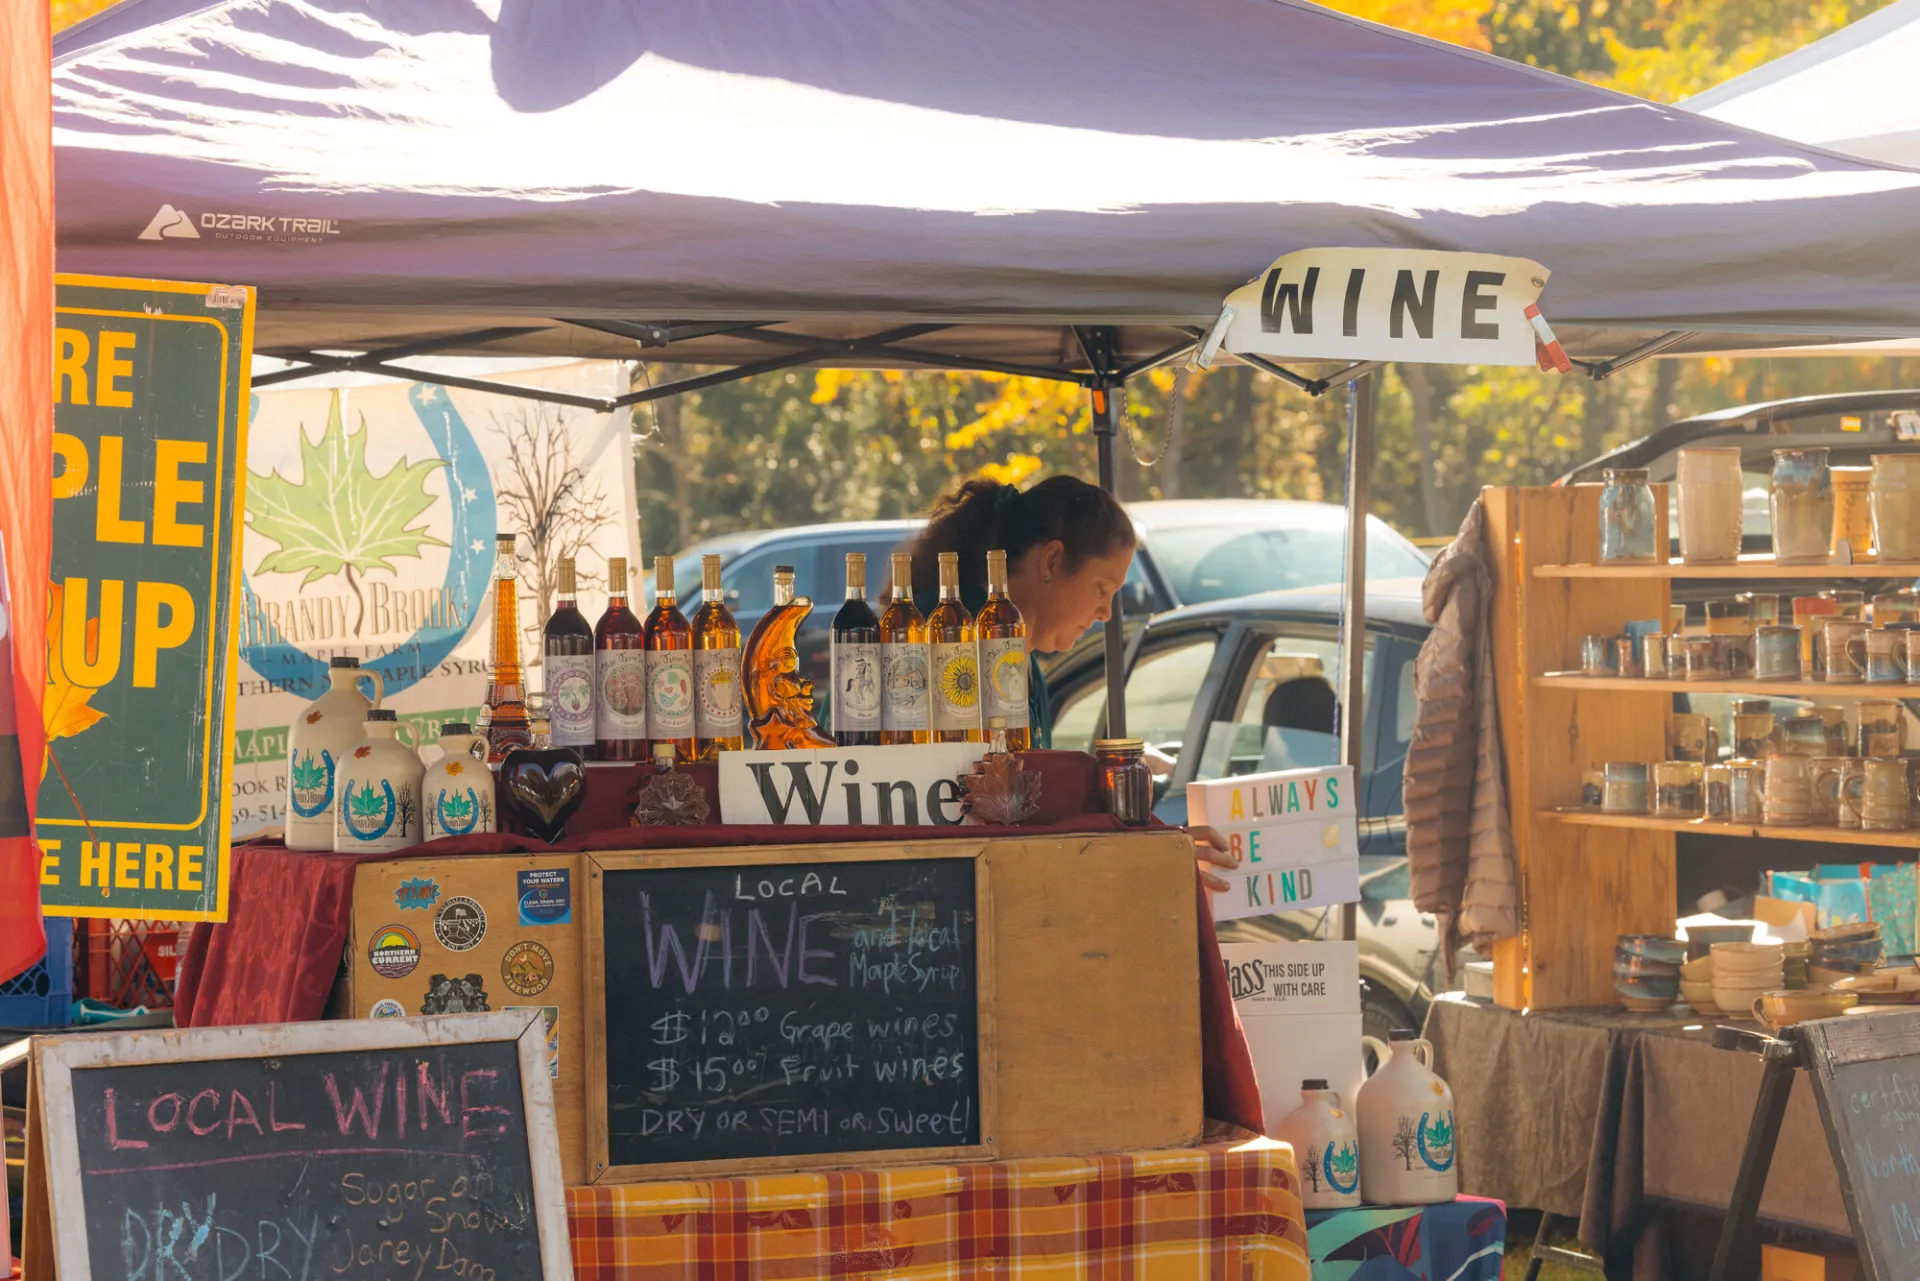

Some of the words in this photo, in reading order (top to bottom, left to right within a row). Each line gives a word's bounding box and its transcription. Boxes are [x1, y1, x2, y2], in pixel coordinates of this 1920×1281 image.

[215, 233, 262, 241] OUTDOOR
[267, 235, 323, 244] EQUIPMENT
[1260, 266, 1507, 340] WINE
[47, 577, 195, 688] UP
[243, 591, 351, 647] BRANDY
[370, 581, 463, 635] BROOK
[365, 642, 421, 658] FARM
[745, 759, 966, 825] Wine
[1229, 776, 1339, 821] ALWAYS
[80, 841, 204, 891] HERE
[1229, 830, 1262, 863] BE
[735, 872, 847, 901] LOCAL
[1246, 868, 1313, 908] KIND
[639, 888, 837, 995] WINE
[853, 904, 901, 952] and
[372, 955, 418, 964] CURRENT
[505, 943, 528, 962] DON'T
[532, 944, 552, 966] MOVE
[1263, 964, 1285, 978] THIS
[1287, 963, 1309, 978] SIDE
[1312, 963, 1325, 977] UP
[504, 974, 548, 995] FIREWOOD
[1274, 983, 1298, 996] WITH
[1301, 982, 1326, 996] CARE
[780, 1010, 854, 1050] Grape
[868, 1007, 958, 1040] wines
[781, 1054, 860, 1086] Fruit
[874, 1052, 965, 1082] wines
[105, 1079, 306, 1151] LOCAL
[322, 1054, 511, 1140] WINE
[642, 1108, 705, 1140] DRY
[716, 1113, 750, 1130] OR
[760, 1108, 830, 1136] SEMI
[216, 1210, 319, 1281] DRY
